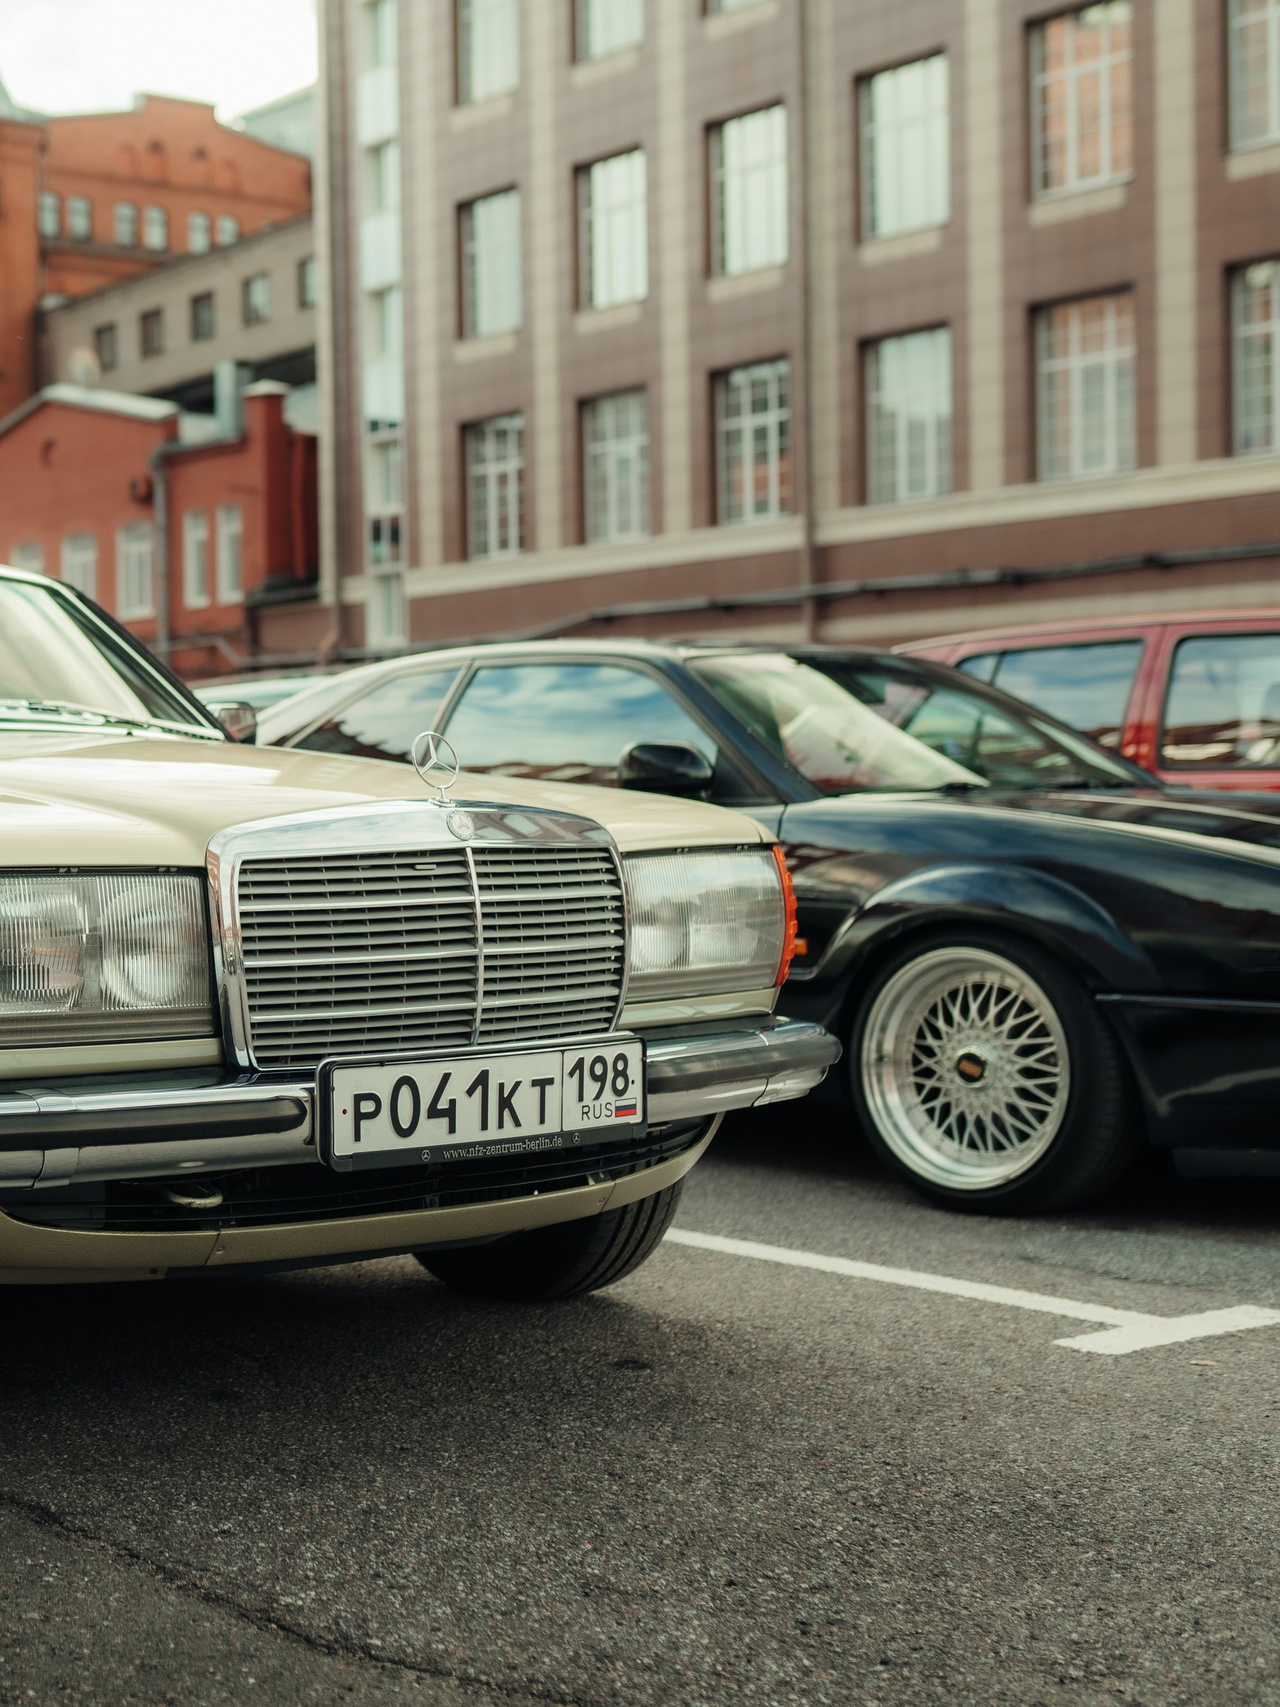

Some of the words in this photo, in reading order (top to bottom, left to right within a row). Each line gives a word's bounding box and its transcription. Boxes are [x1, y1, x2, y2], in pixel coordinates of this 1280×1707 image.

[568, 1052, 629, 1103] 198
[581, 1102, 613, 1121] RUS
[443, 1136, 563, 1160] www.nfz-zentrum-berlin.de
